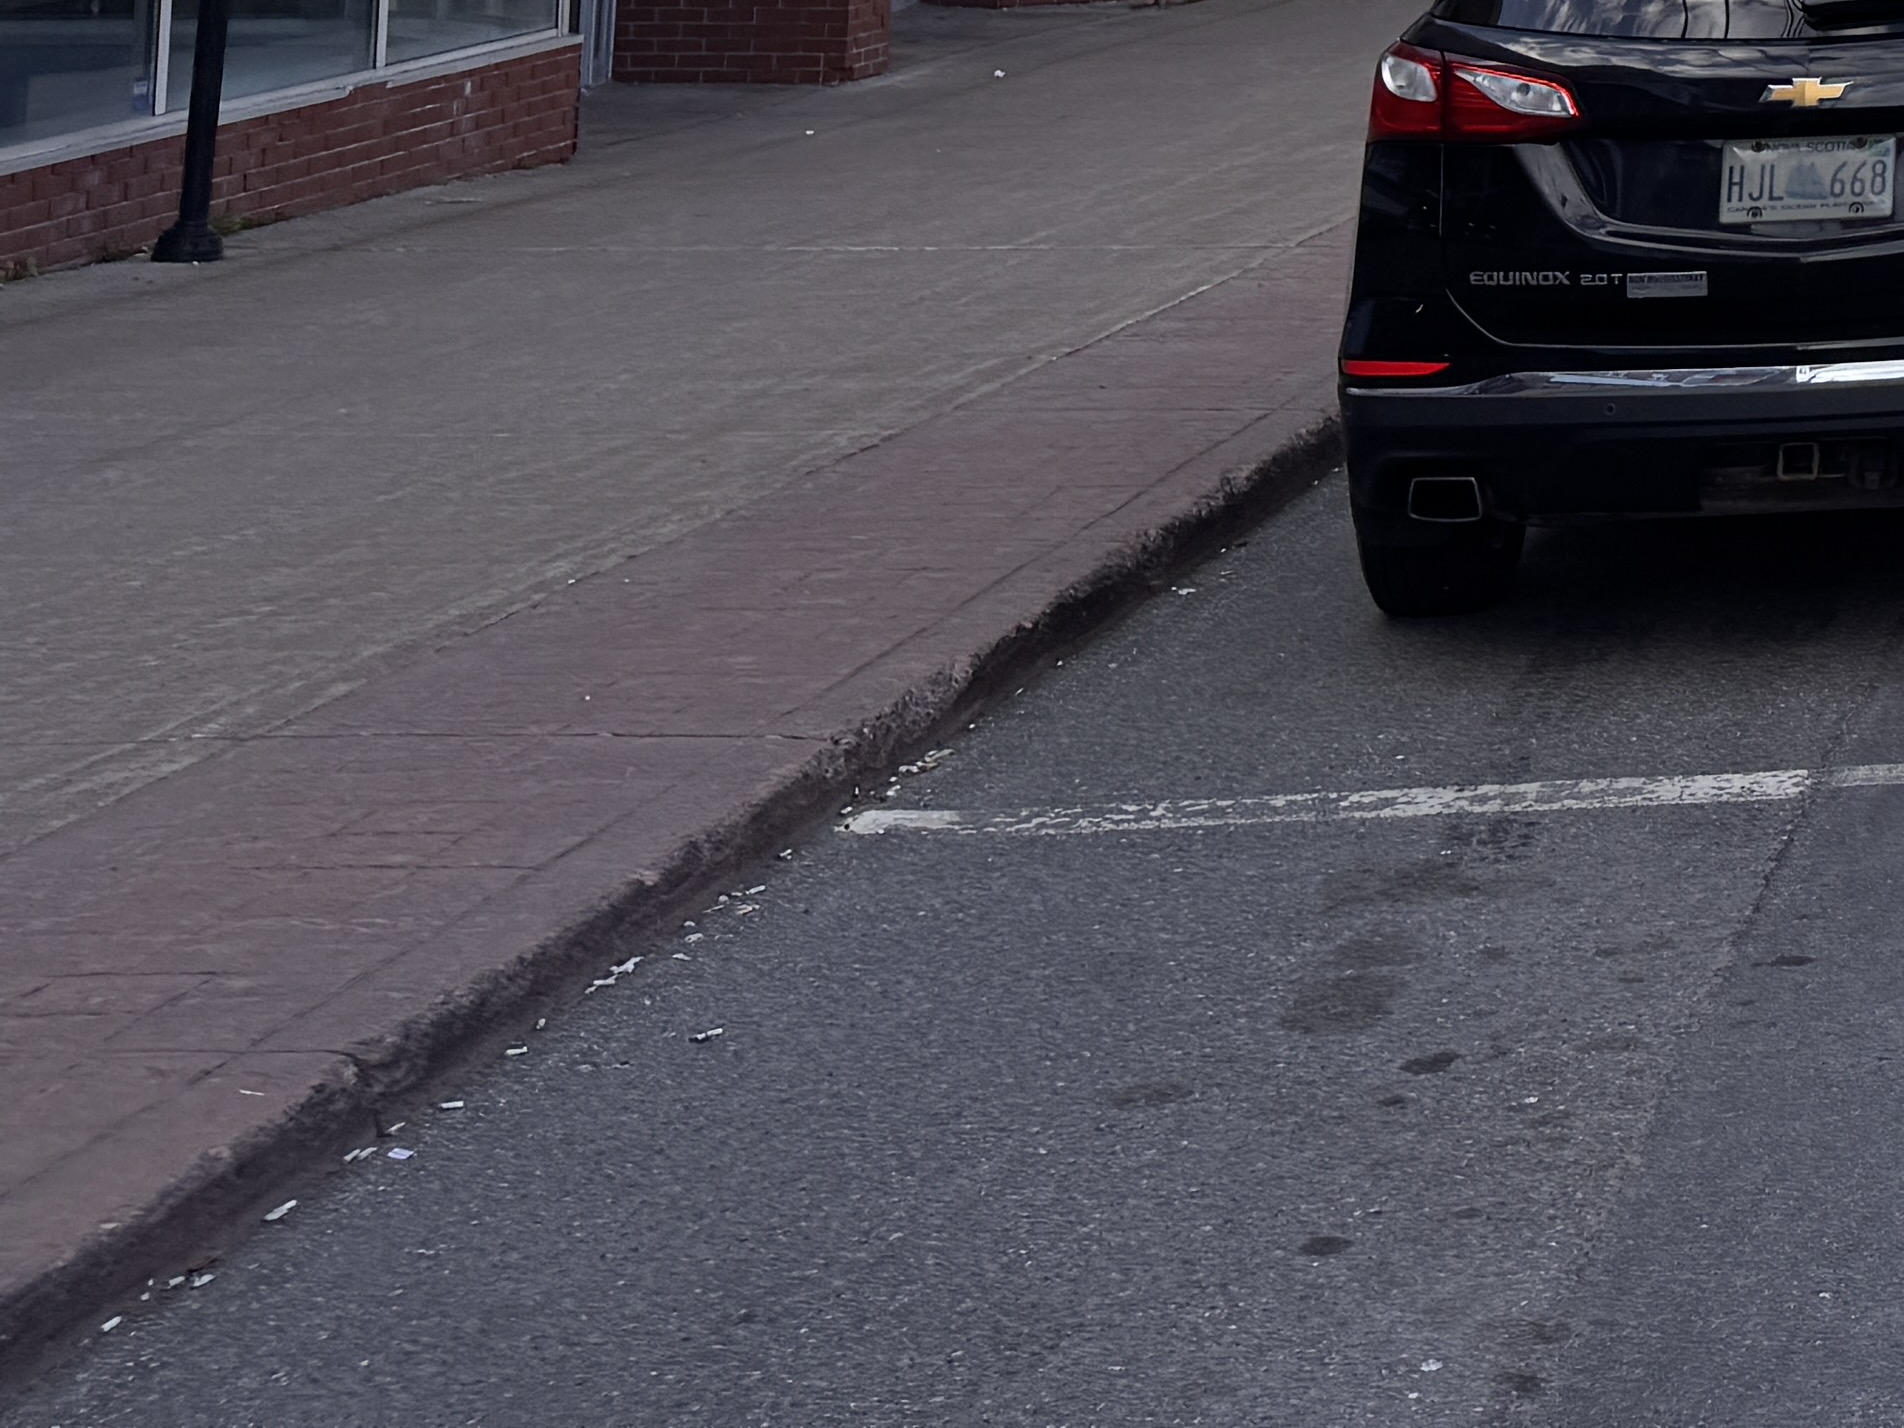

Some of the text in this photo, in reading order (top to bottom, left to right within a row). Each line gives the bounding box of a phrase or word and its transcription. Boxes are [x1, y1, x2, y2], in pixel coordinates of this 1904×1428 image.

[1727, 159, 1887, 203] HJL 668
[1469, 271, 1571, 286] EQUINOX
